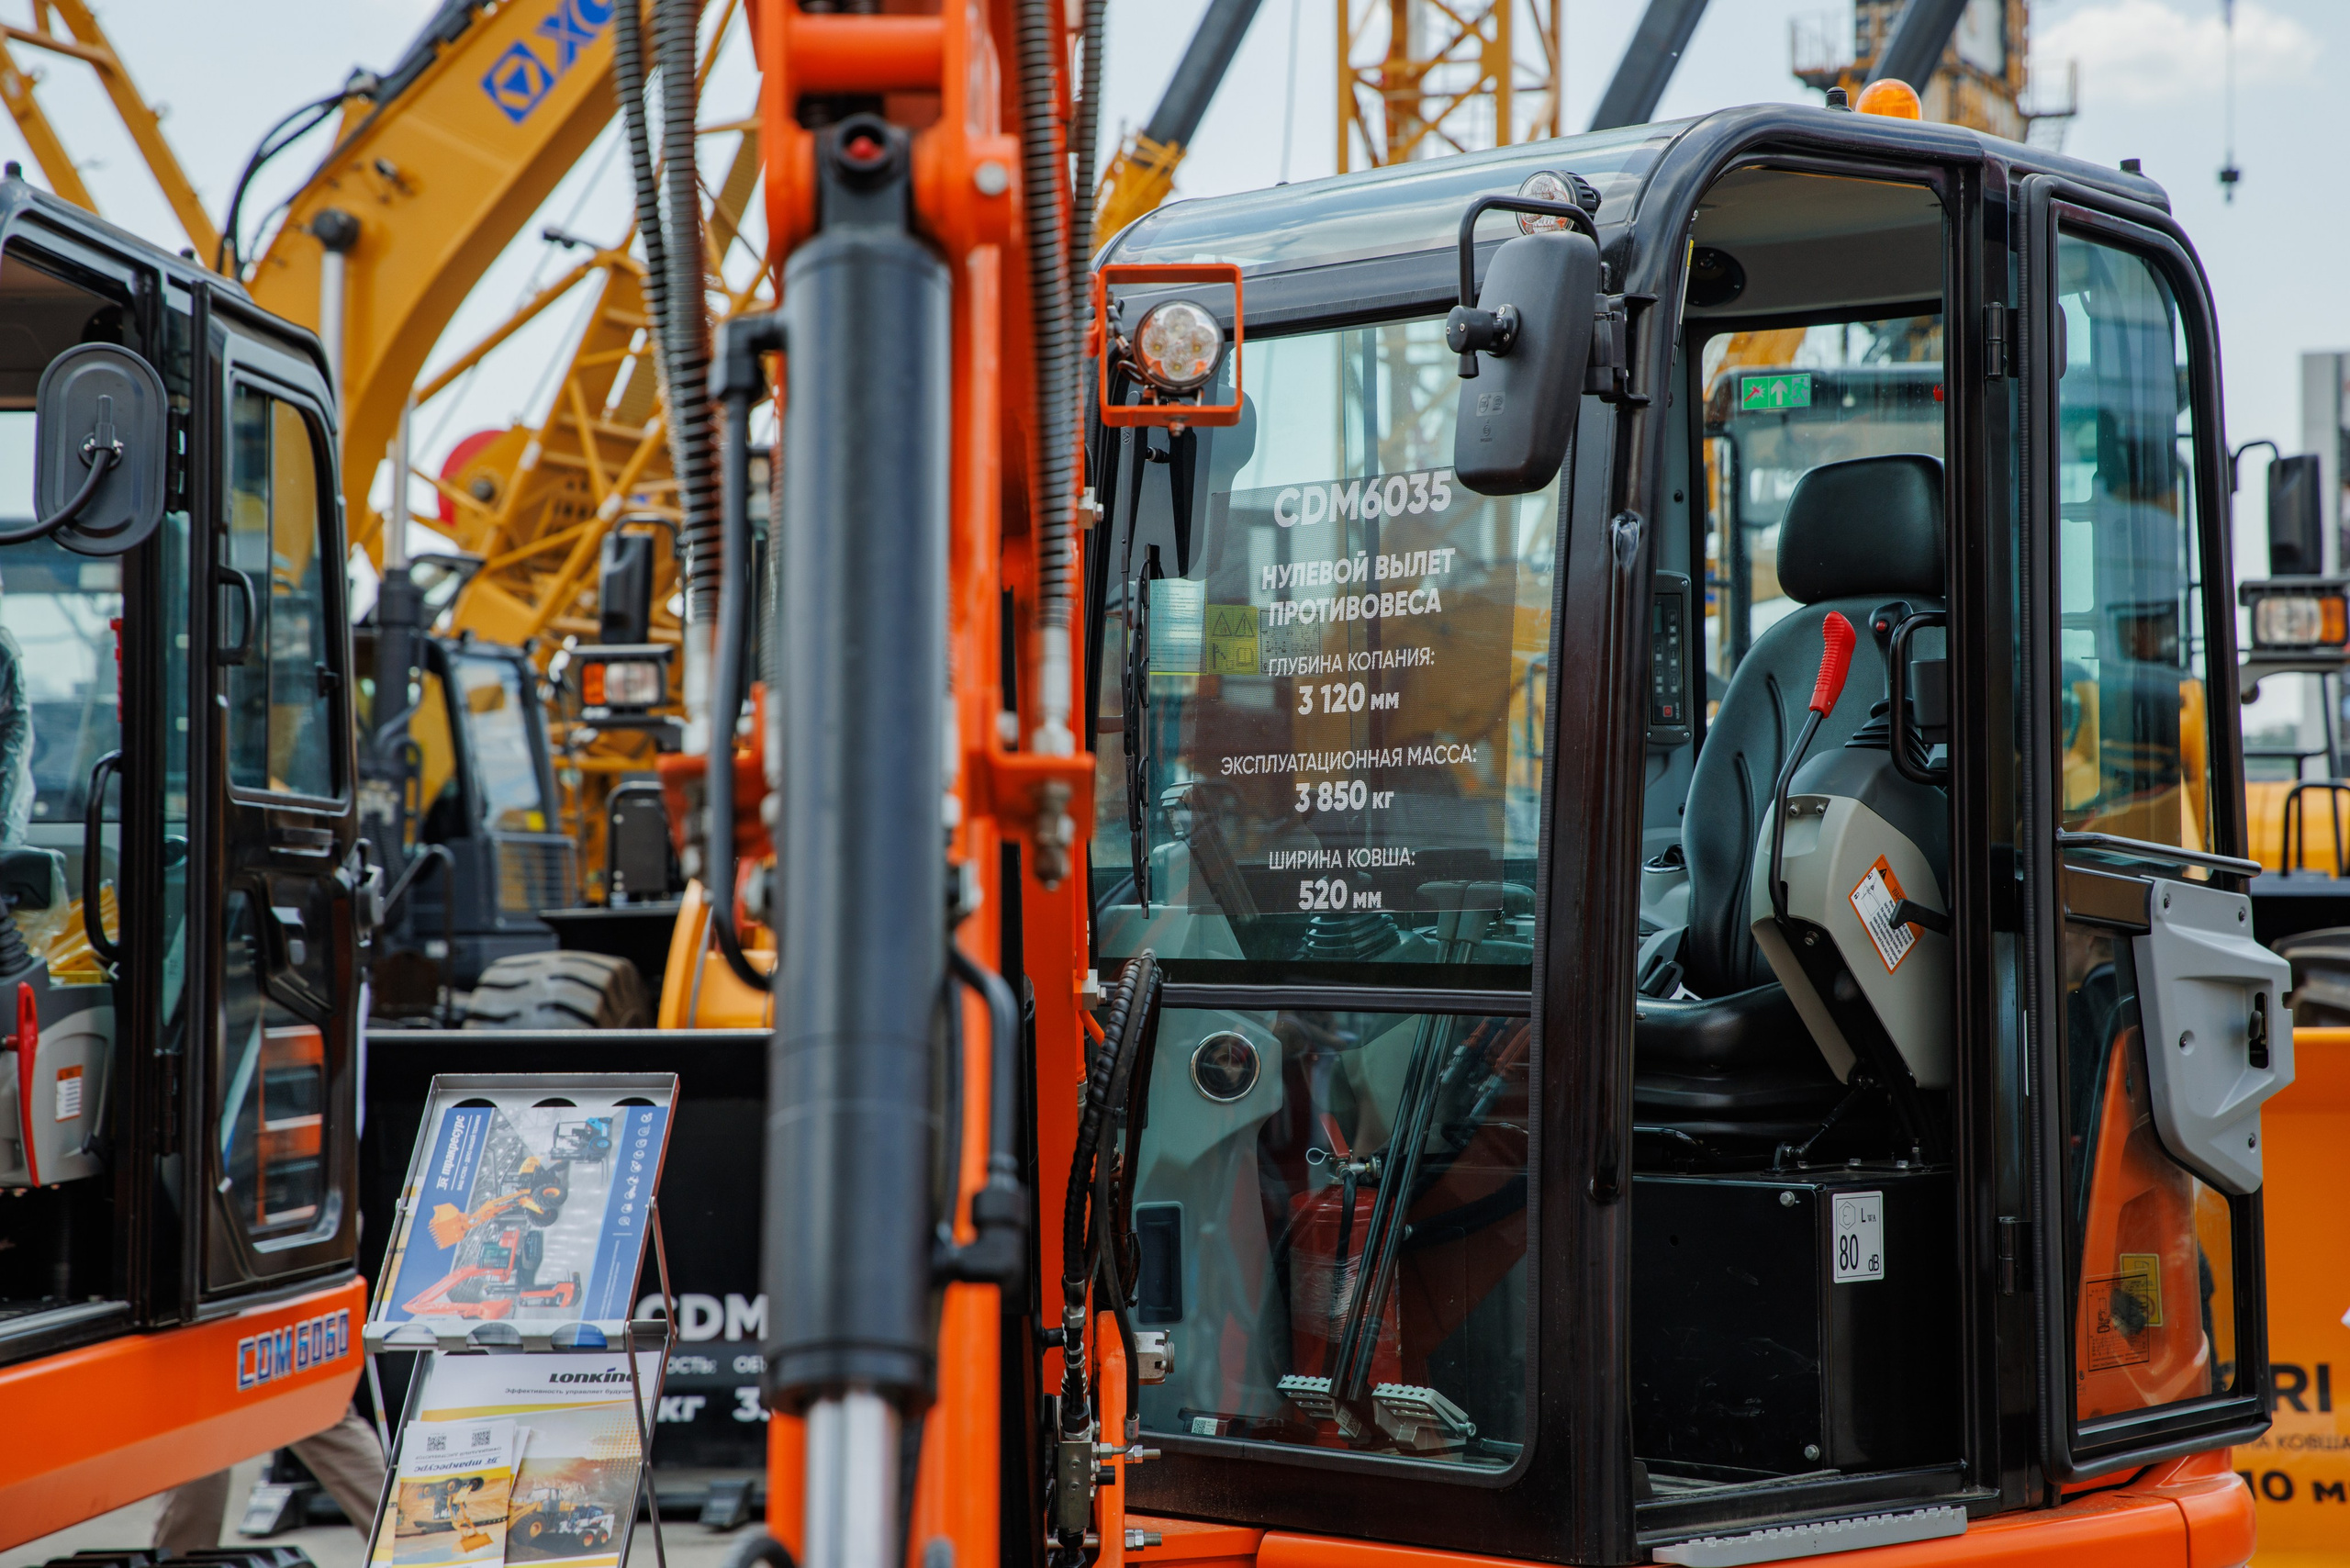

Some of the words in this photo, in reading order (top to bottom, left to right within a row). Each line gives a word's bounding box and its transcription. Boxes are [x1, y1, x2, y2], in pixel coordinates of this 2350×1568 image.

[1273, 470, 1452, 528] CDM6035
[1261, 552, 1369, 590] НУЛЕВОЙ
[1375, 548, 1456, 577] ВЫЛЕТ
[1268, 588, 1442, 627] ПРОТИВОВЕСА
[1268, 651, 1343, 678] ГЛУБИНА
[1348, 646, 1435, 672] КОПАНИЯ:
[1298, 686, 1314, 715] 3
[1320, 682, 1366, 712] 120
[1220, 747, 1402, 776] ЭКСПЛУАТАЦИОННАЯ
[1406, 744, 1477, 767] МАССА:
[1294, 782, 1309, 812] 3
[1316, 780, 1367, 811] 850
[1372, 790, 1394, 810] кг
[1269, 848, 1342, 870] ШИРИНА
[1348, 846, 1416, 868] КОВША:
[1298, 879, 1348, 910] 520
[442, 1114, 465, 1175] тракресурс
[1840, 1234, 1859, 1271] 80
[1868, 1254, 1880, 1271] dB
[414, 1459, 483, 1473] тракресурс
